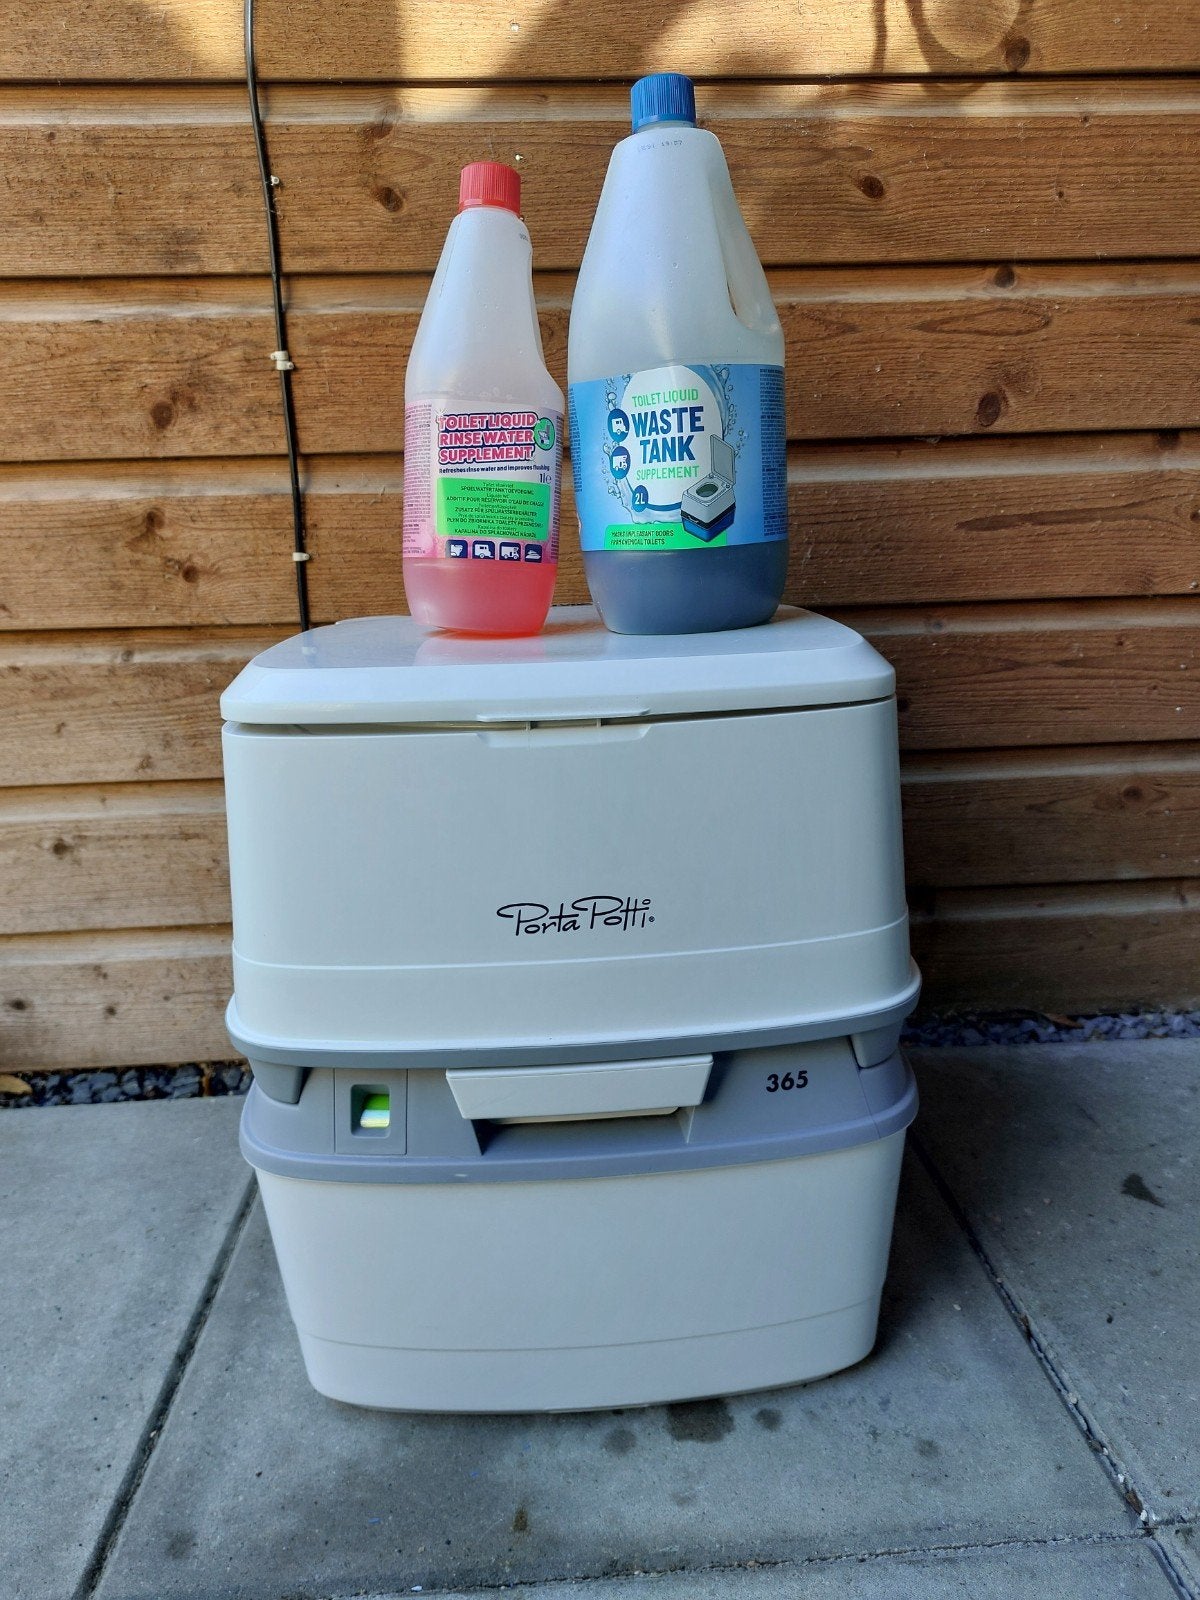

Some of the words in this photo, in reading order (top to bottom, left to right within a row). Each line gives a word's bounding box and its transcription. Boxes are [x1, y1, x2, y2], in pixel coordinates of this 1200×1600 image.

[632, 392, 662, 408] TOILET
[664, 389, 699, 404] LIQUID
[438, 414, 488, 430] TOILET
[488, 413, 537, 429] LIQUID
[631, 406, 705, 438] WASTE
[440, 432, 483, 446] RINSE
[483, 430, 535, 445] WATER
[440, 446, 533, 463] SUPPLEMENT
[640, 435, 696, 465] TANK
[508, 464, 532, 472] improves
[636, 466, 700, 481] SUPPLEMENT
[635, 493, 646, 505] 2L
[497, 903, 580, 936] Porta
[571, 895, 652, 931] Potti
[766, 1070, 808, 1093] 365
